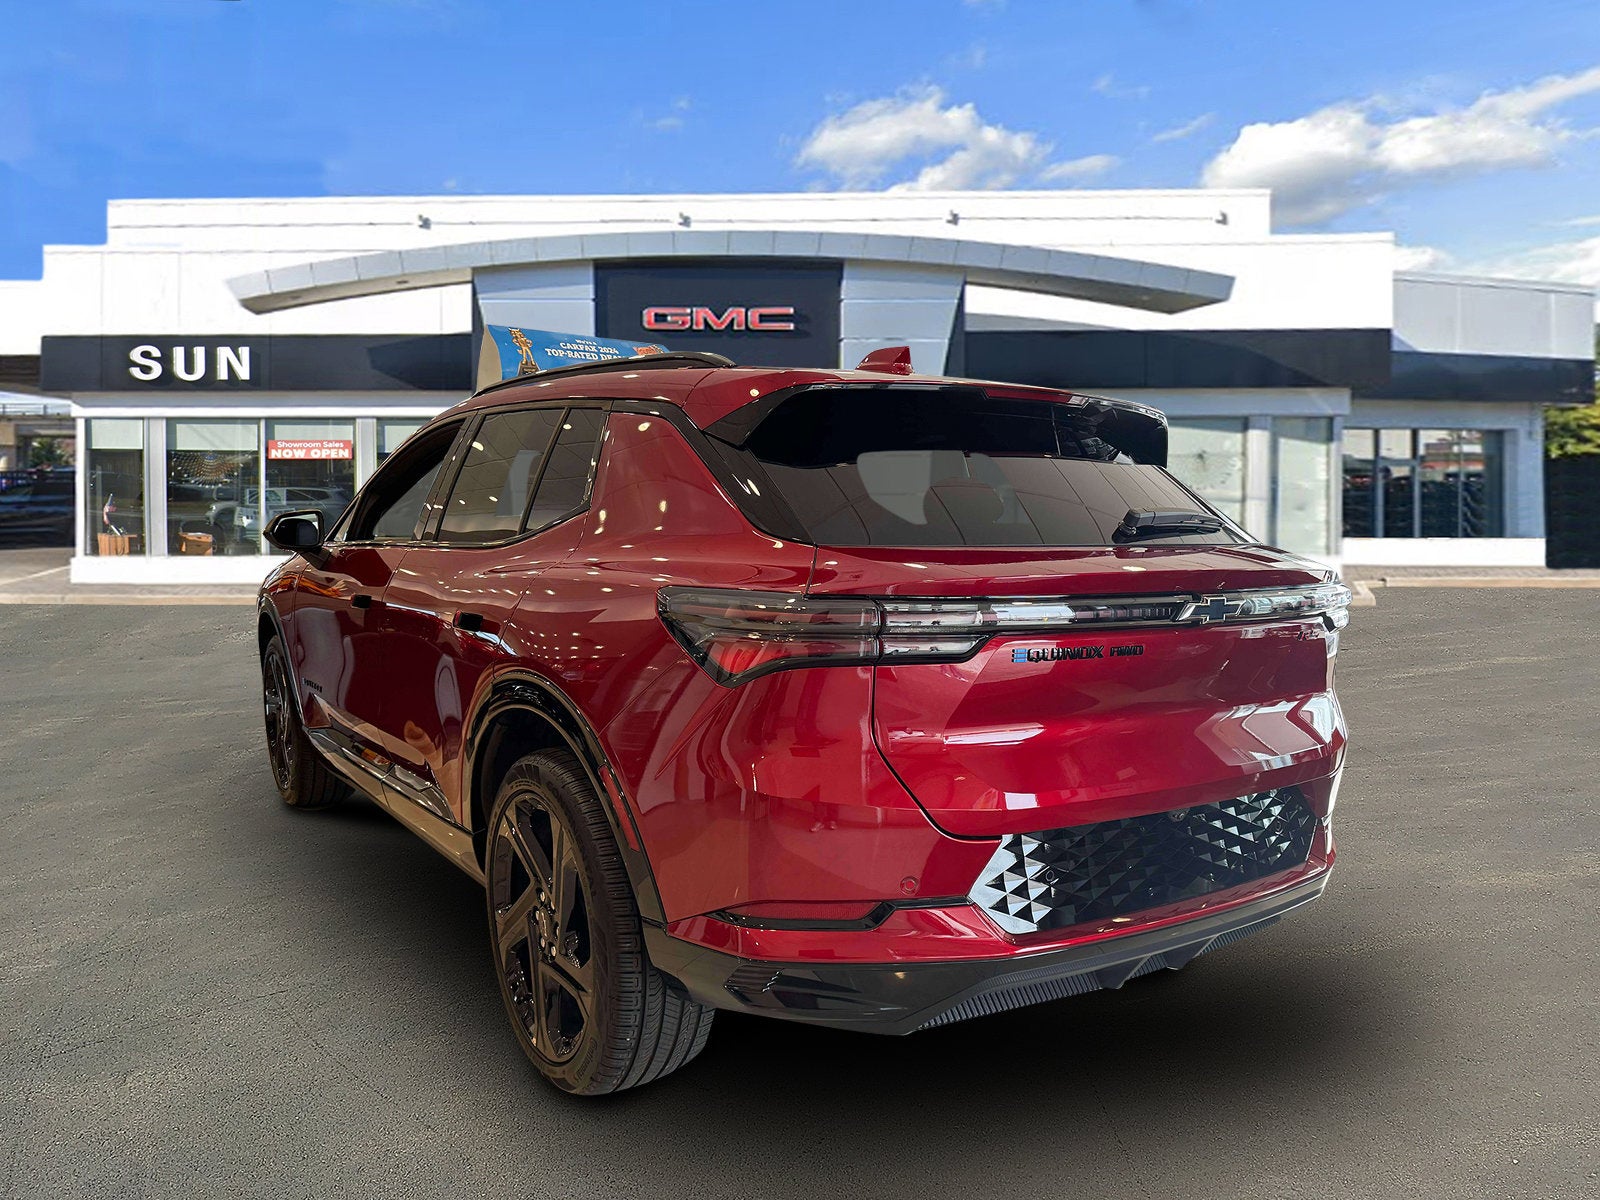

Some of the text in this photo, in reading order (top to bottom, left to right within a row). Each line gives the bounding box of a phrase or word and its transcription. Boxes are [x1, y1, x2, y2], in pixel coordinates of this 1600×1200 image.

[642, 306, 795, 330] GMC
[545, 348, 599, 361] TOP-RATED
[559, 342, 620, 355] CARFAX 2024
[128, 344, 251, 381] SUN
[271, 448, 349, 458] NOW OPEN
[1109, 645, 1144, 657] AWD
